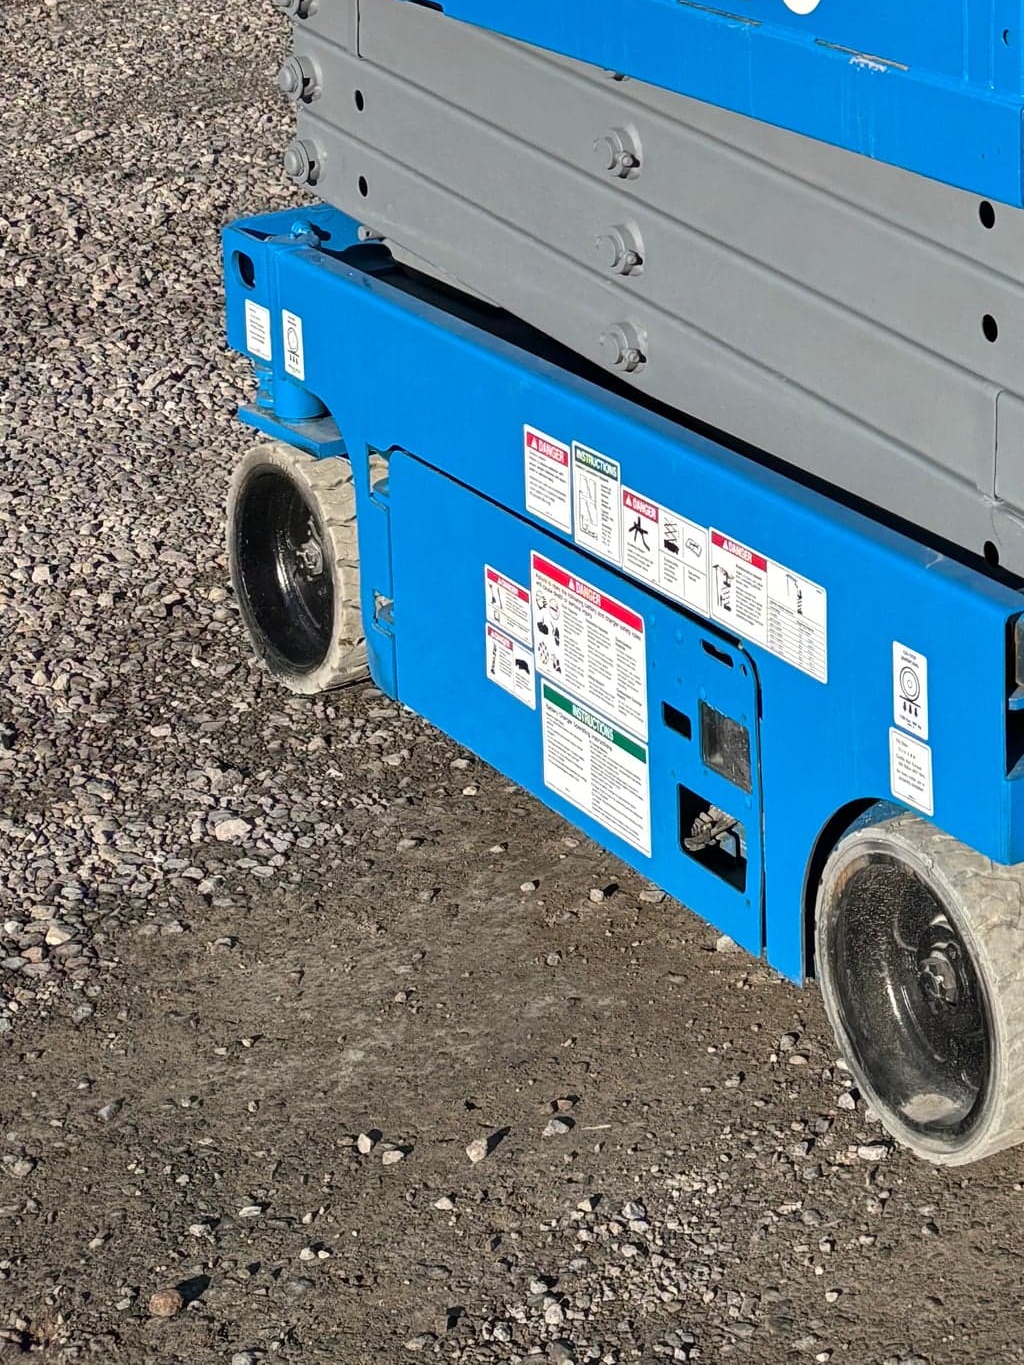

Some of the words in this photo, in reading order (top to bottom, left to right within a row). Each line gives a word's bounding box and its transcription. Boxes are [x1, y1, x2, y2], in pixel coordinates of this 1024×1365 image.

[538, 439, 564, 464] DANGER
[576, 449, 617, 478] INSTRUCTIONS
[575, 581, 601, 608] DANGER
[572, 704, 614, 741] INSTRUCTIONS
